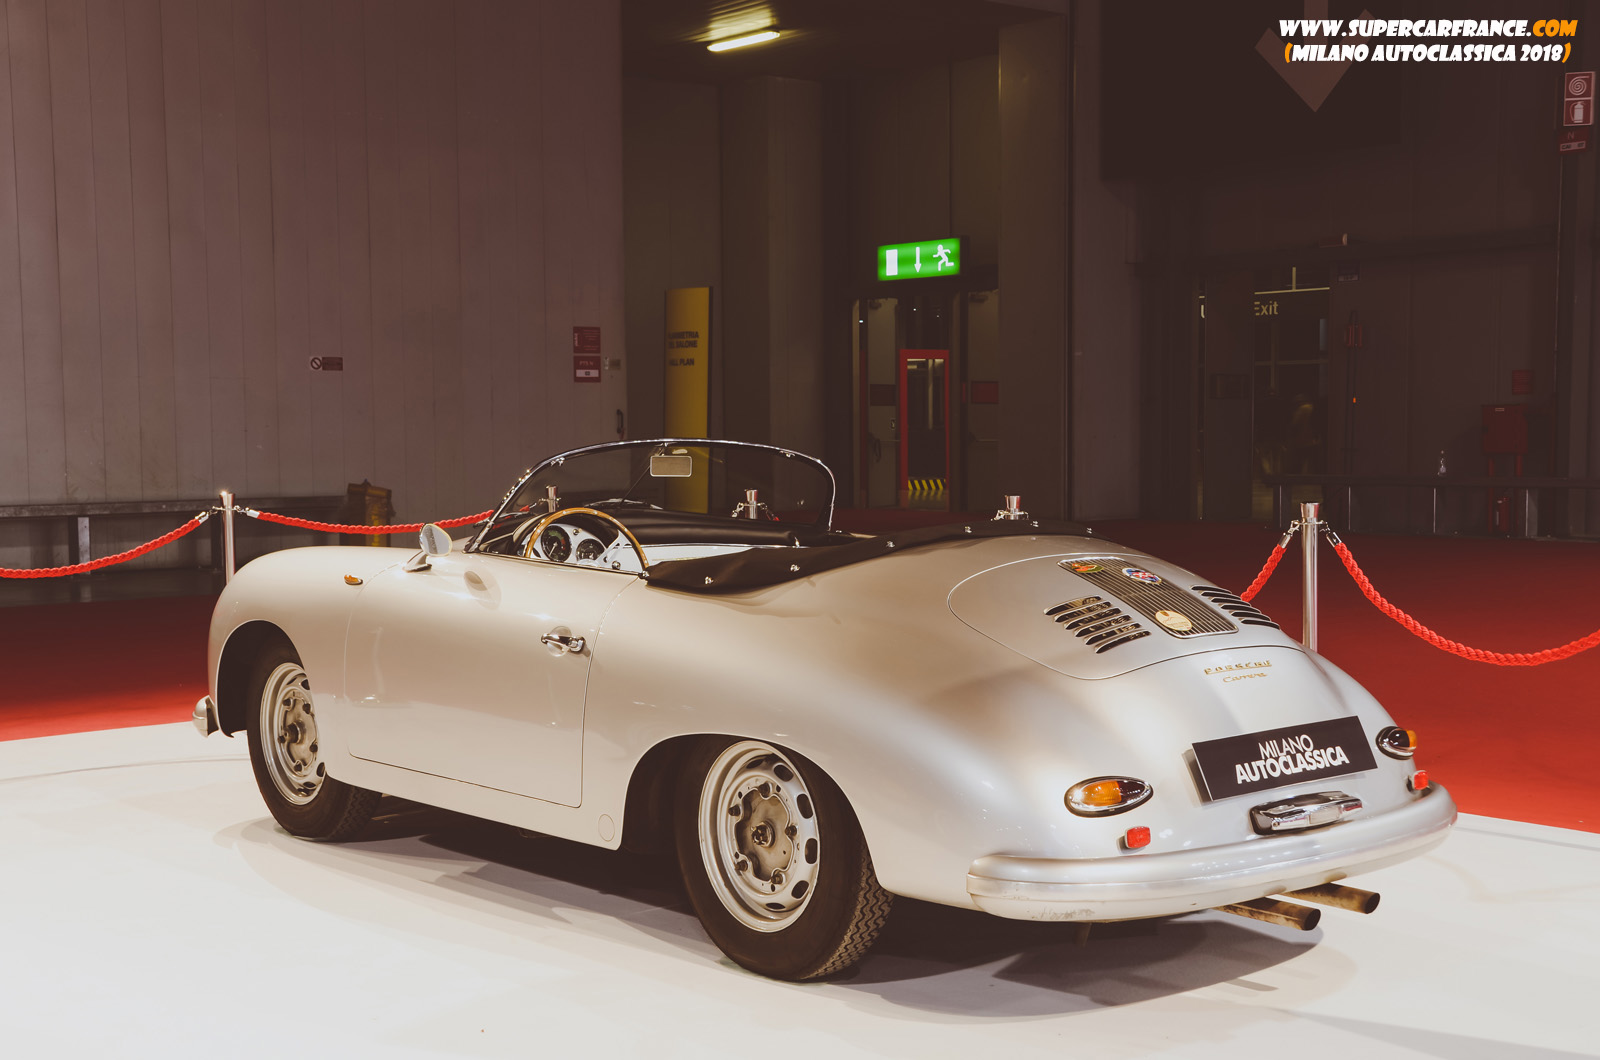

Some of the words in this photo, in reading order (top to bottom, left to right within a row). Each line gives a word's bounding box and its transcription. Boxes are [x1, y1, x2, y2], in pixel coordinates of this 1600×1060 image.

[1254, 300, 1279, 316] Exit
[679, 357, 695, 367] PLAN
[1258, 735, 1313, 759] MILANO
[1236, 746, 1349, 784] AUTOCLASSICA
